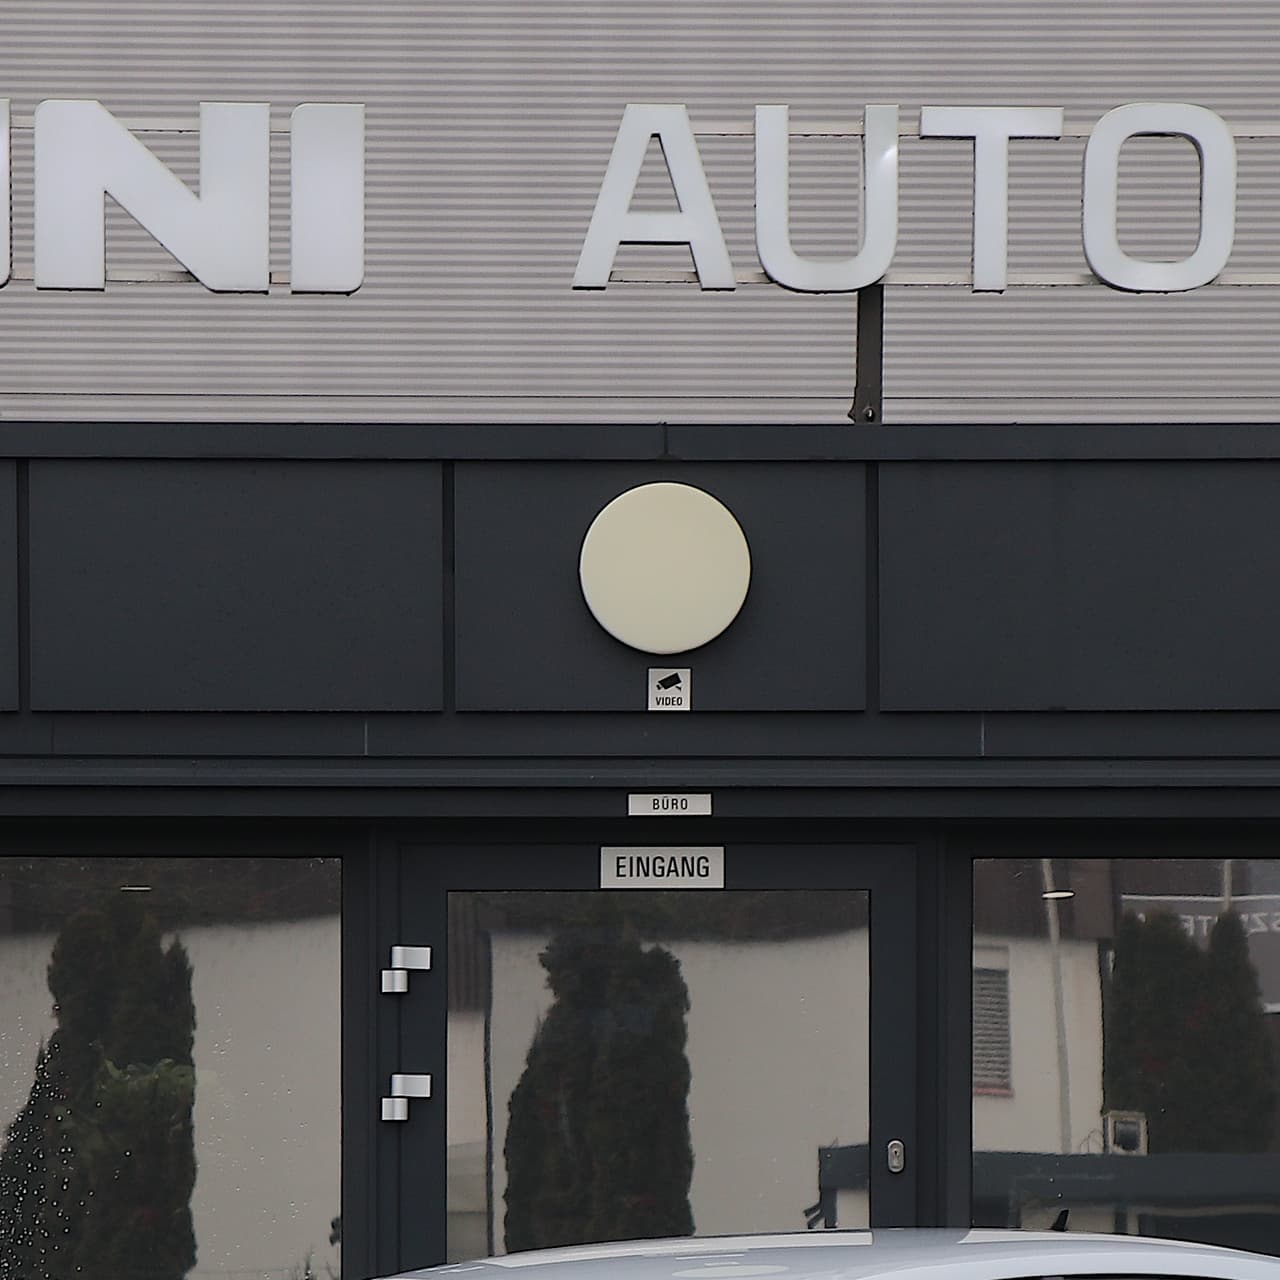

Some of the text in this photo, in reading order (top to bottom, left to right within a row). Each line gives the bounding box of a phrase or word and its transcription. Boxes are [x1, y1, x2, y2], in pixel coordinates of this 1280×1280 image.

[570, 100, 1237, 294] AUTO
[655, 696, 683, 707] VIDEO
[652, 796, 688, 810] BÜRO
[615, 855, 710, 878] EINGANG
